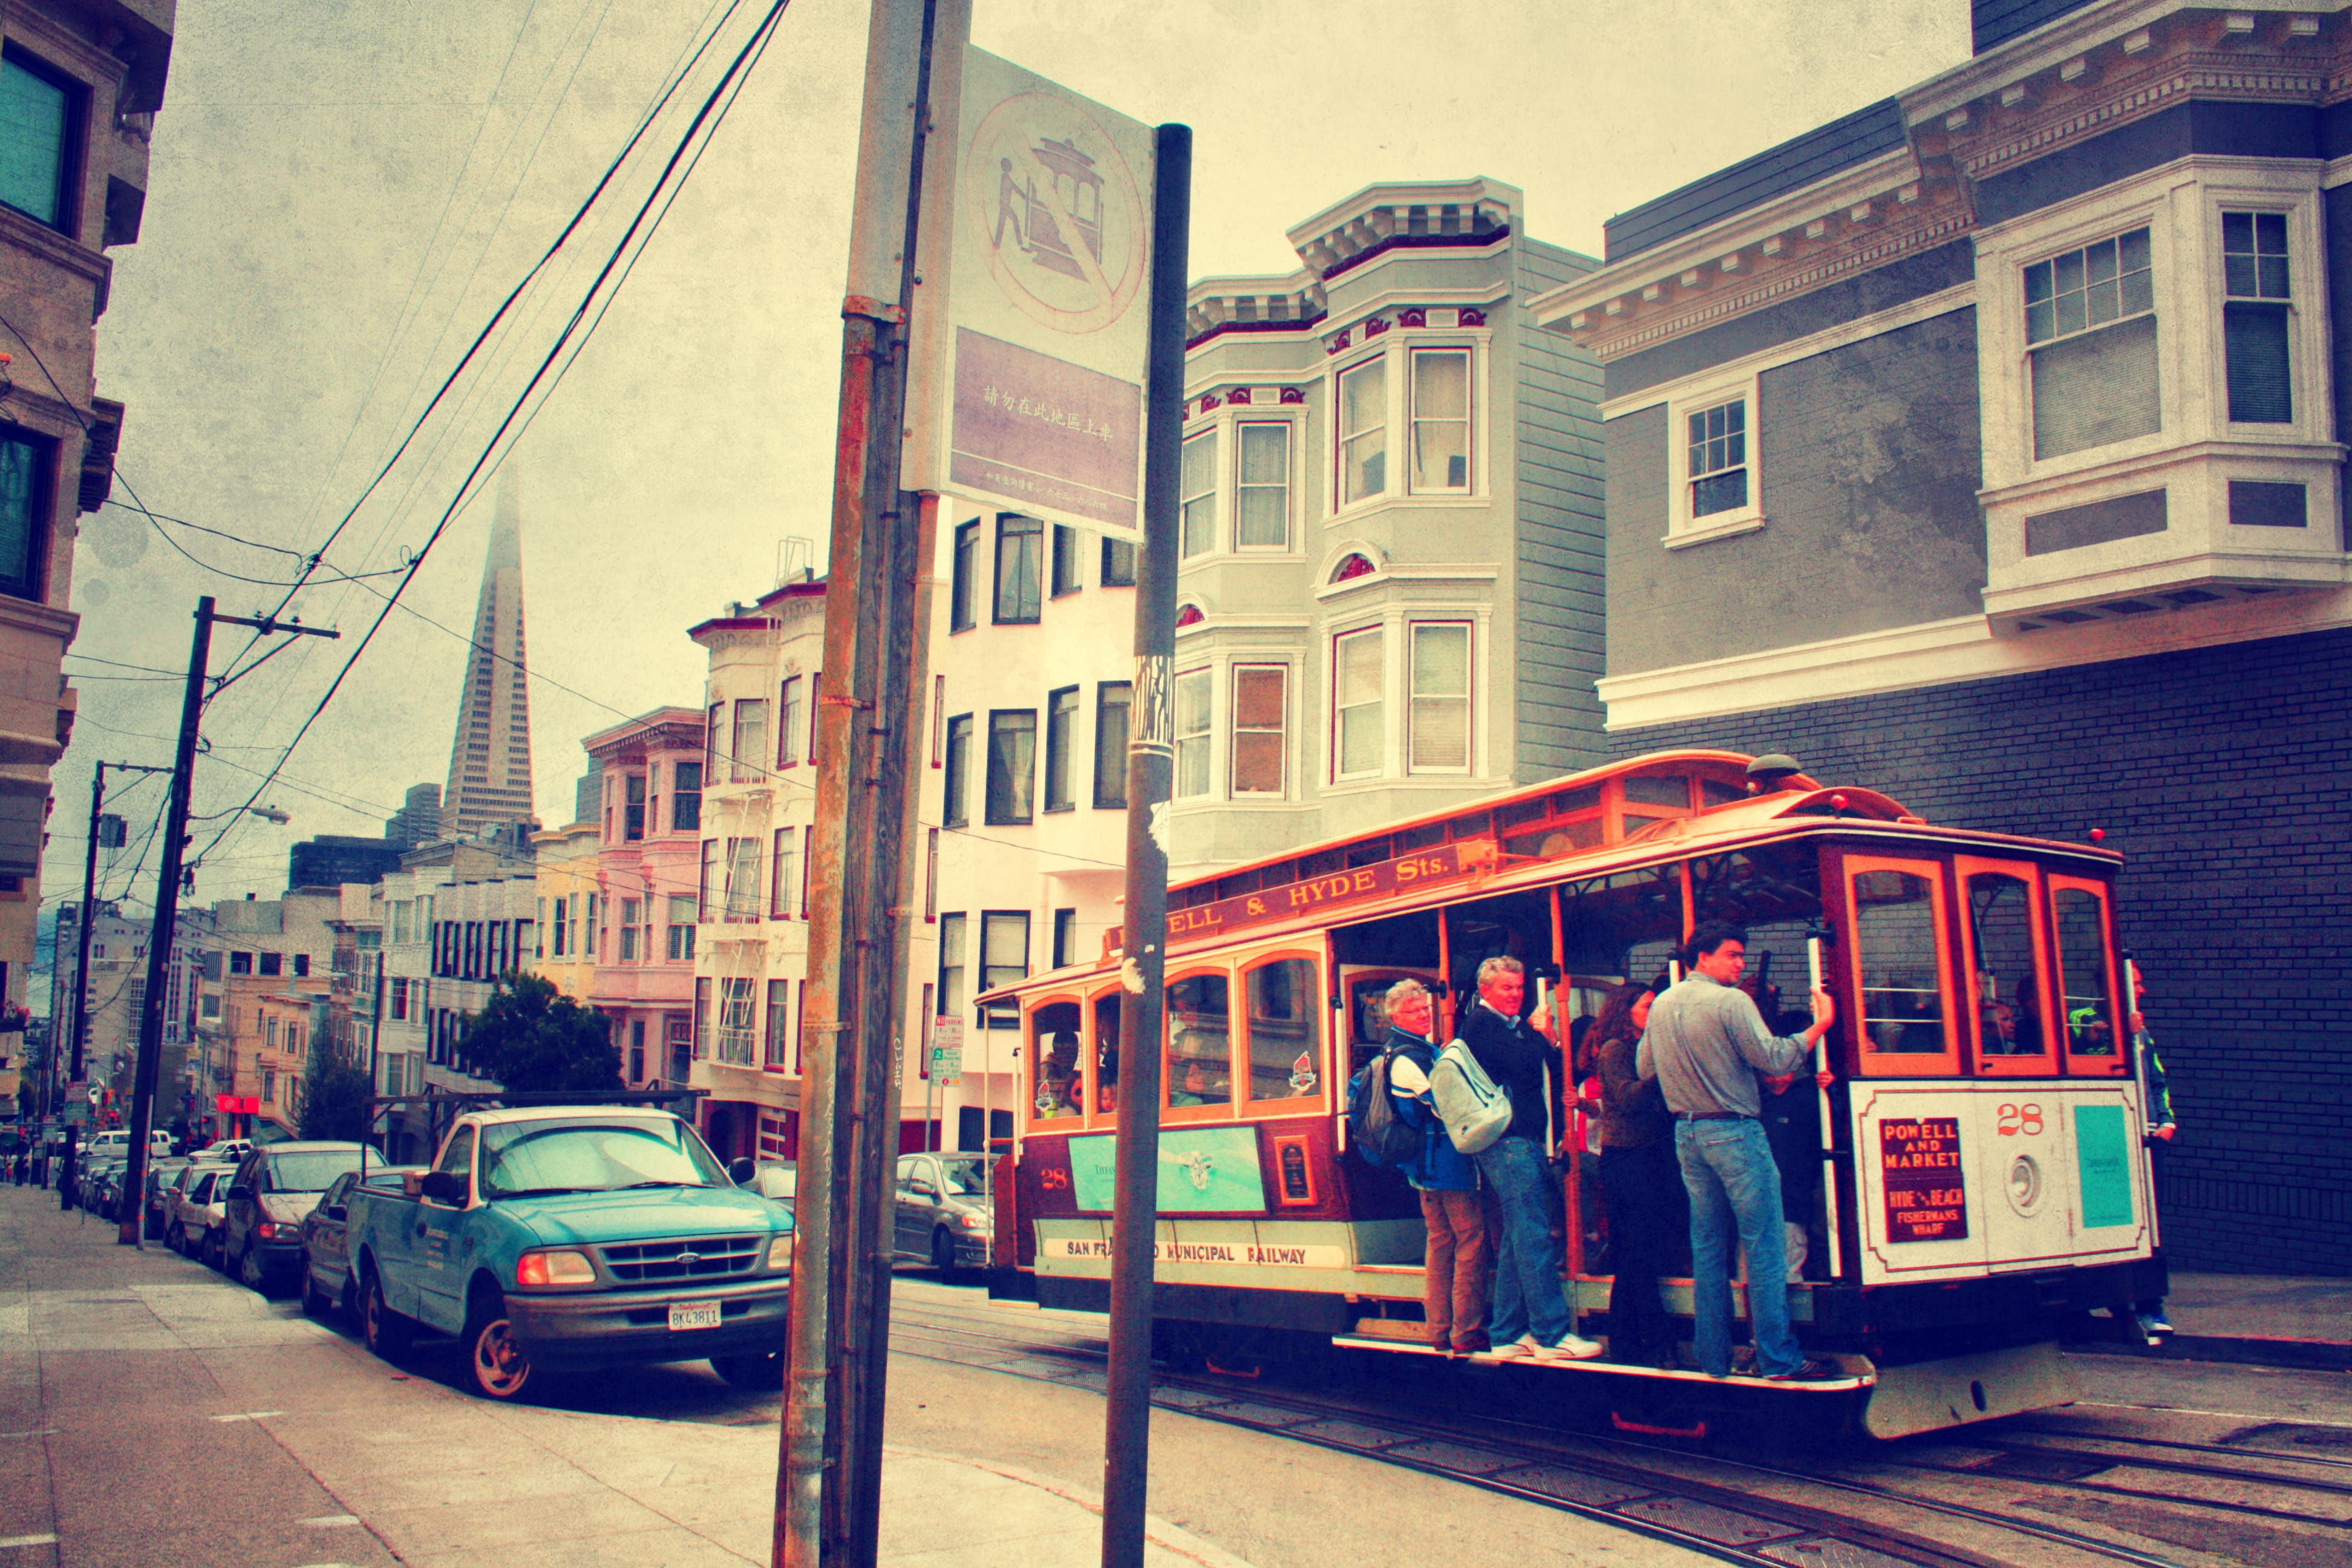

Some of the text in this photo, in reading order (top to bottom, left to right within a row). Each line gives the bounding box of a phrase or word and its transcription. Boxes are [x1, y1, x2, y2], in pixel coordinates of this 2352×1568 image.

[984, 385, 1113, 442] 請勿在此地區上車
[1246, 897, 1267, 916] &
[1289, 869, 1376, 906] HYDE
[1396, 857, 1449, 882] Sts.
[937, 1016, 945, 1025] NO
[935, 1050, 942, 1059] 2
[1998, 1103, 2043, 1136] 28
[1884, 1125, 1957, 1140] POWELL
[1905, 1140, 1942, 1152] AND
[1885, 1152, 1959, 1168] MARKET
[1040, 1168, 1067, 1190] 28
[1930, 1188, 1964, 1206] BEACH
[1912, 1223, 1945, 1235] WHARF
[1068, 1241, 1089, 1255] SAN
[1167, 1244, 1235, 1261] MUNICIPAL
[1247, 1247, 1306, 1264] RAILWAY
[673, 1310, 717, 1325] 8K43811
